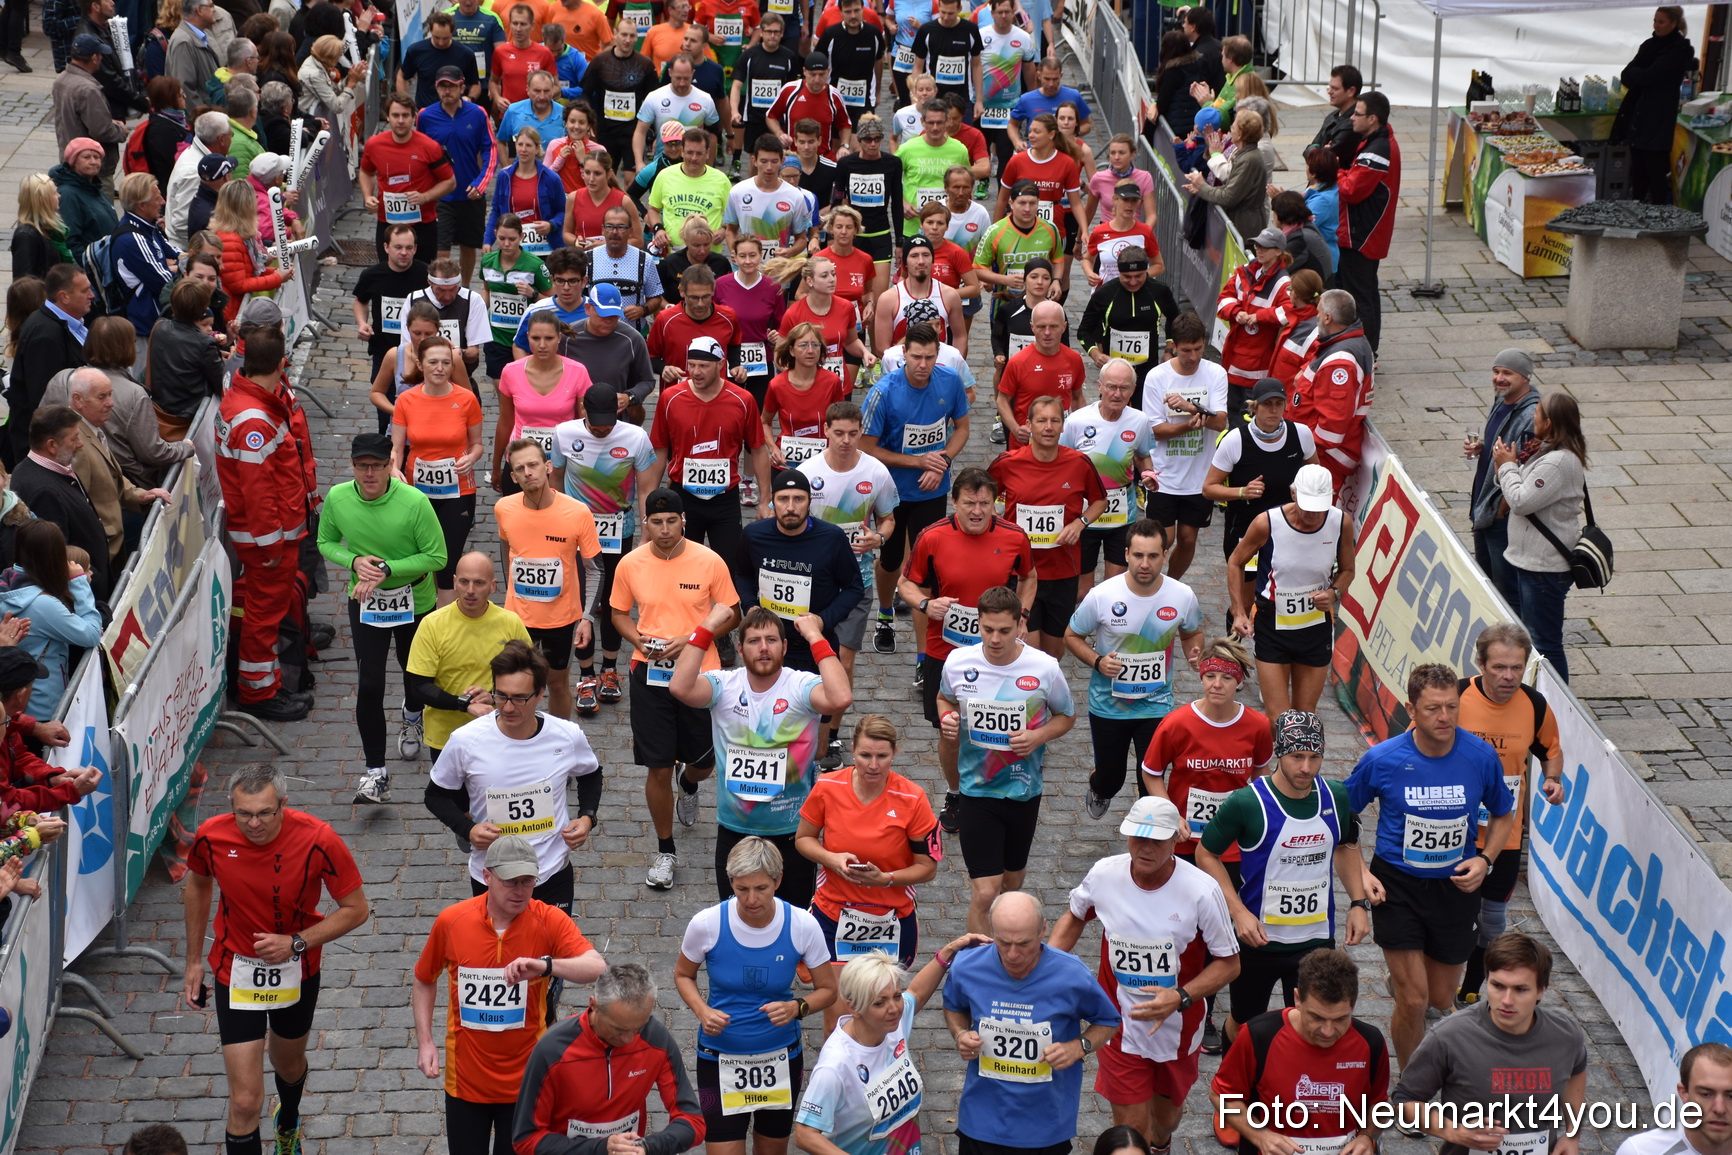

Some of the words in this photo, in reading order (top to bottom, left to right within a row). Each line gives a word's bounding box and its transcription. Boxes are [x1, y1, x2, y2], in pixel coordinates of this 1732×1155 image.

[717, 25, 740, 35] 2084
[940, 63, 963, 74] 2270
[754, 86, 778, 97] 2281
[840, 85, 864, 96] 2135
[611, 98, 630, 111] 124
[984, 108, 1008, 119] 2488
[918, 158, 952, 166] NOVINA
[853, 182, 882, 194] 2249
[668, 194, 713, 210] FINISHER
[386, 306, 401, 319] 27
[494, 300, 524, 315] 2596
[1118, 340, 1141, 354] 176
[908, 428, 943, 446] 2365
[417, 468, 452, 485] 2491
[688, 469, 726, 484] 2043
[1026, 516, 1055, 532] 146
[776, 559, 812, 573] RUN
[516, 567, 557, 585] 2587
[760, 573, 776, 582] PARTL
[777, 577, 802, 585] Neumarkt
[525, 588, 548, 596] Markus
[773, 584, 795, 602] 58
[366, 595, 410, 612] 2644
[770, 602, 795, 614] Charles
[949, 614, 979, 634] 236
[960, 636, 972, 645] Jan
[1118, 663, 1161, 681] 2758
[1019, 678, 1038, 688] Hervis
[1131, 685, 1146, 693] Jörg
[973, 711, 1021, 732] 2505
[732, 758, 778, 781] 2541
[1187, 758, 1246, 769] NEUMARKT
[511, 789, 541, 798] Neumarkt
[740, 784, 768, 794] Markus
[1404, 785, 1465, 799] HUBER
[1190, 793, 1208, 801] PARTL
[508, 798, 535, 820] 53
[1193, 802, 1222, 820] 23
[522, 820, 553, 832] Antonio
[1407, 819, 1428, 829] PARTL
[1290, 833, 1326, 844] ERTEL
[1411, 829, 1462, 850] 2545
[1424, 852, 1448, 862] Anton
[1292, 884, 1320, 892] Neumarkt
[1279, 893, 1318, 914] 536
[842, 912, 861, 922] PARTL
[843, 922, 894, 941] 2224
[1110, 939, 1129, 948] PARTL
[1115, 949, 1170, 973] 2514
[253, 967, 281, 988] 68
[1128, 977, 1159, 986] Johann
[254, 993, 278, 1002] Peter
[464, 982, 521, 1007] 2424
[991, 1008, 1032, 1017] HALBMARATHON
[1000, 1002, 1034, 1010] WALLENSTEIN
[479, 1012, 504, 1022] Klaus
[981, 1022, 1003, 1033] PARTL
[1005, 1028, 1040, 1036] Neumarkt
[993, 1036, 1038, 1060] 320
[744, 1057, 777, 1065] Neumarkt
[994, 1062, 1037, 1075] Reinhard
[734, 1066, 776, 1089] 303
[882, 1065, 904, 1086] Neumarkt
[1491, 1071, 1552, 1090] NIXON
[744, 1094, 768, 1103] Hilde
[877, 1071, 918, 1120] 2646
[570, 1124, 595, 1134] PARTL
[596, 1122, 629, 1134] Neumarkt
